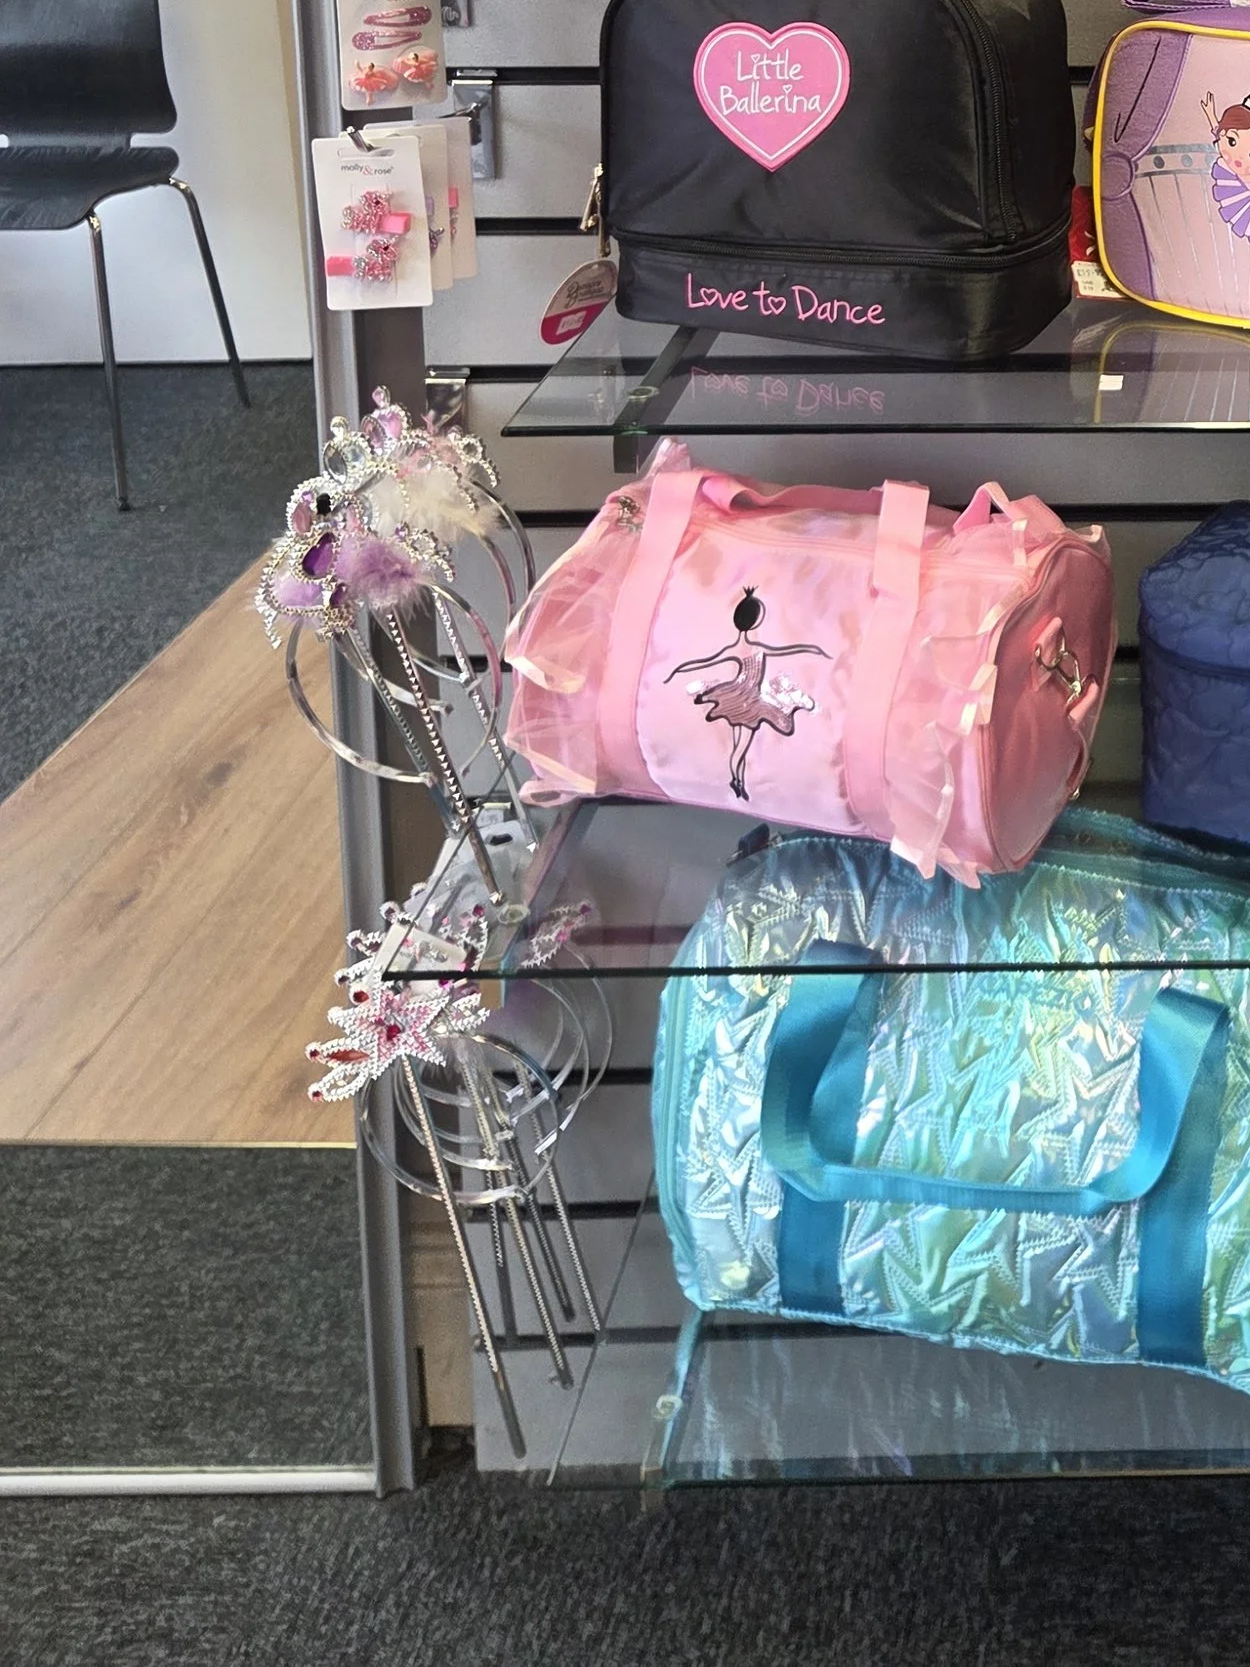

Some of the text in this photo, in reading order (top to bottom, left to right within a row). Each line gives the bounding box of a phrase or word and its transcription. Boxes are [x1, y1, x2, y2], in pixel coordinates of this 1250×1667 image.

[737, 48, 804, 81] Little
[720, 81, 822, 116] Ballerina
[340, 163, 363, 172] molly
[362, 165, 374, 176] &
[686, 272, 887, 325] Love to Dance
